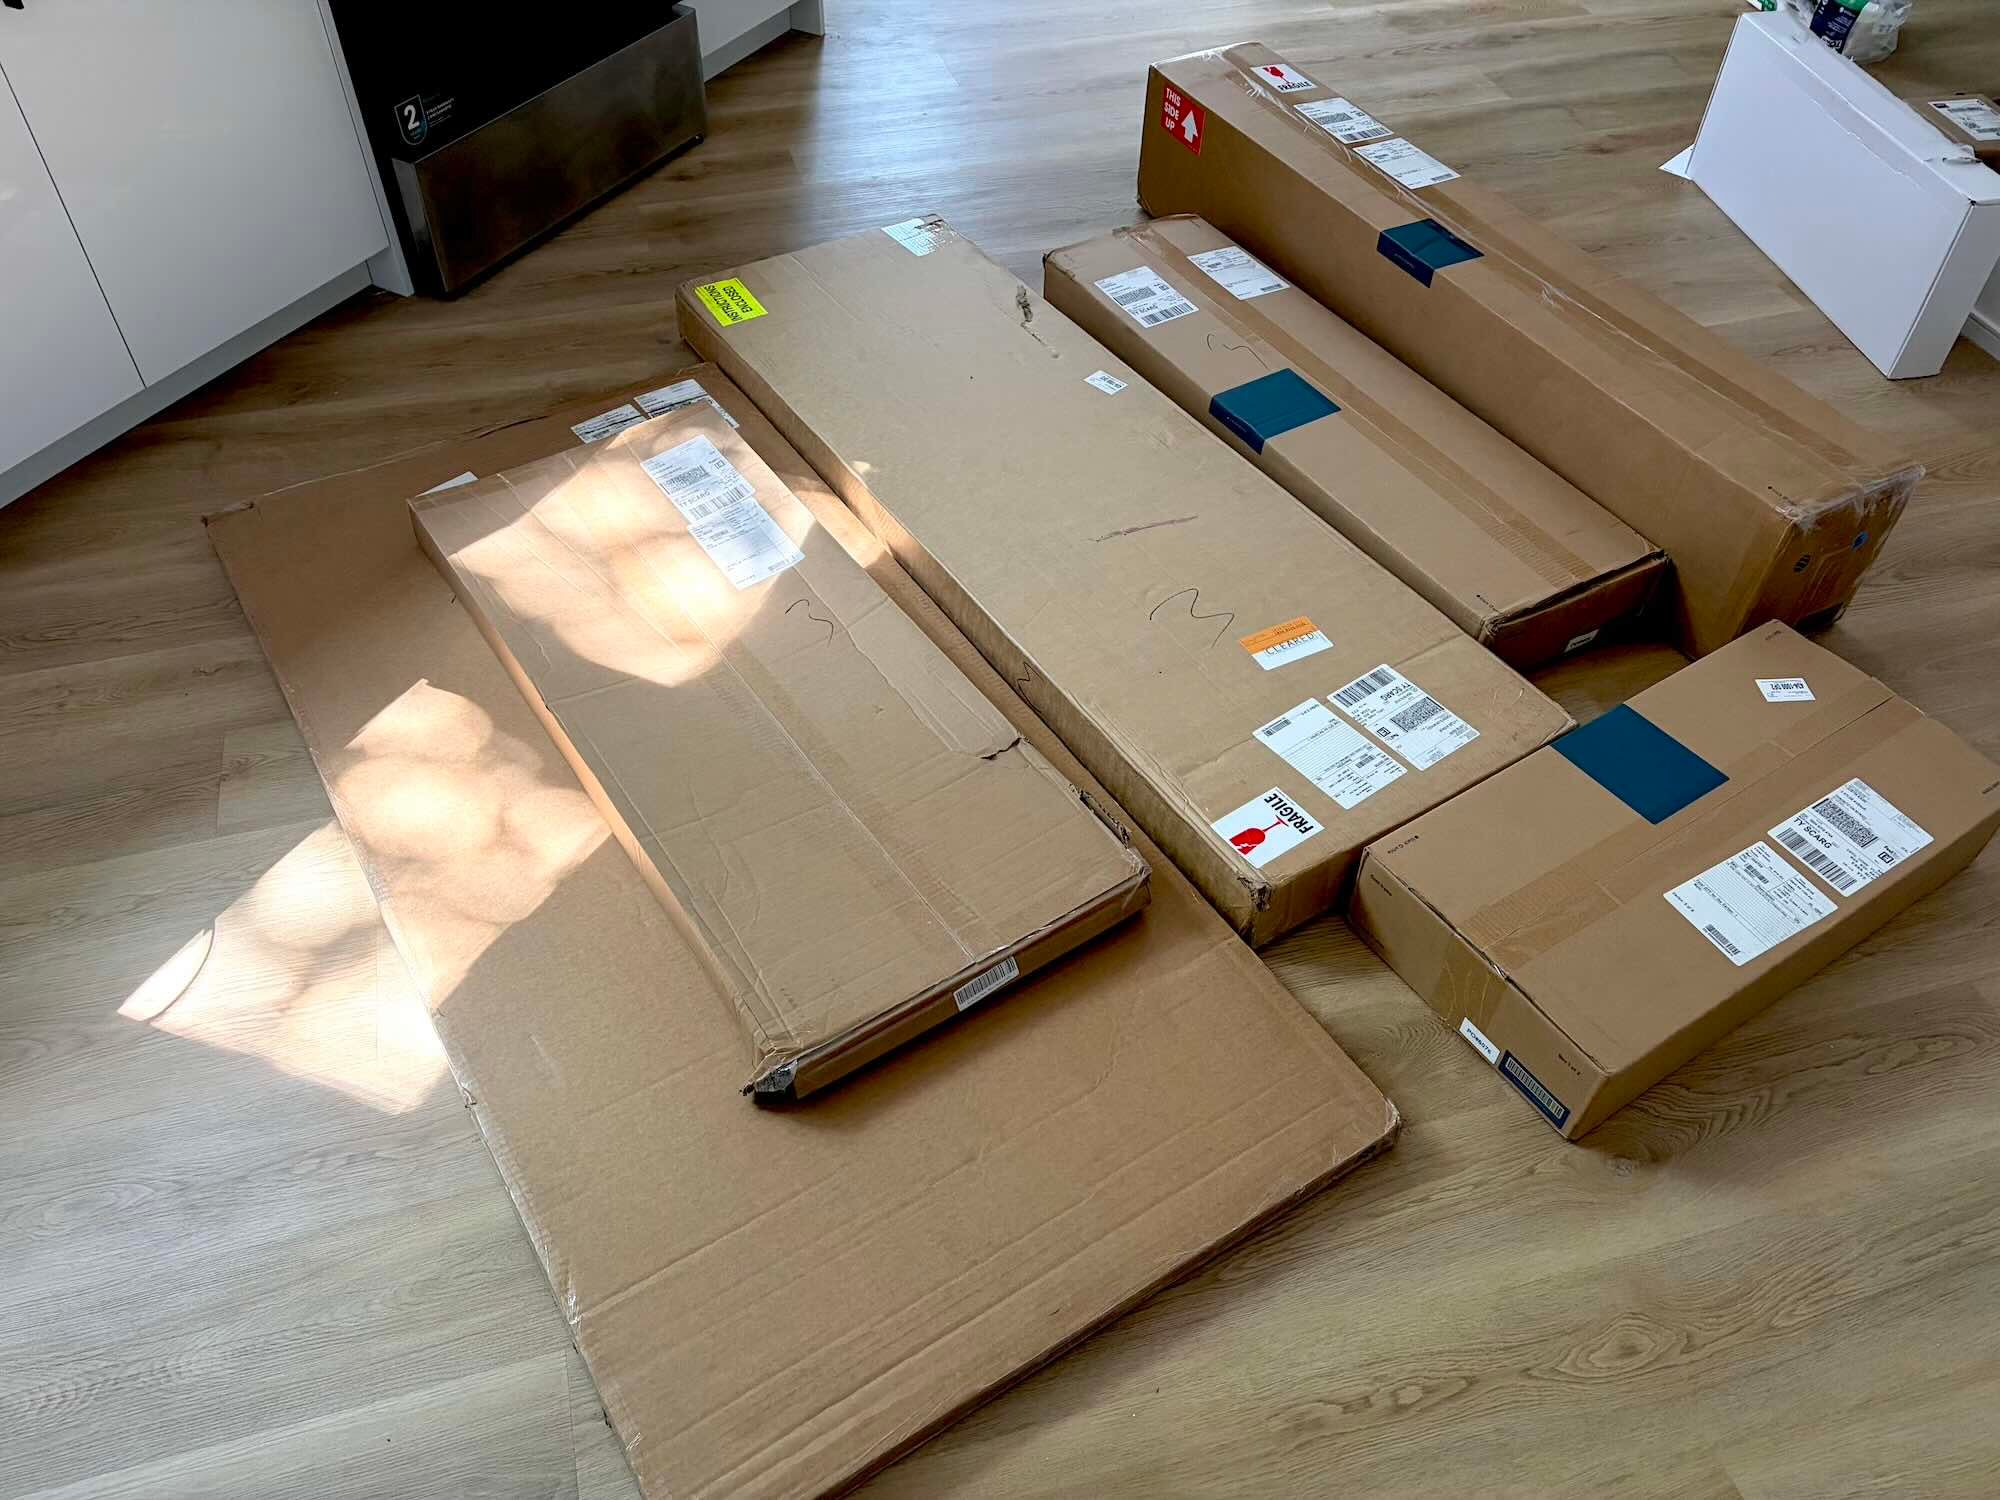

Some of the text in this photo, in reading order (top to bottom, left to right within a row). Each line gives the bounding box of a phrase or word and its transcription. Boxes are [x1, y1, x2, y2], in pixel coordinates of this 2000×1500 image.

[1166, 87, 1181, 107] THIS
[1277, 81, 1313, 91] FRAGILE
[404, 105, 420, 130] 2
[1164, 101, 1180, 120] SIDE
[1165, 117, 1175, 131] UP
[704, 285, 743, 321] INSTRUCTIONS
[723, 286, 753, 313] ENCLOSED
[1264, 630, 1315, 655] CLEARED
[1380, 685, 1402, 701] SCARG
[1263, 793, 1314, 834] FRAGILE
[1793, 816, 1833, 849] TY SCARG
